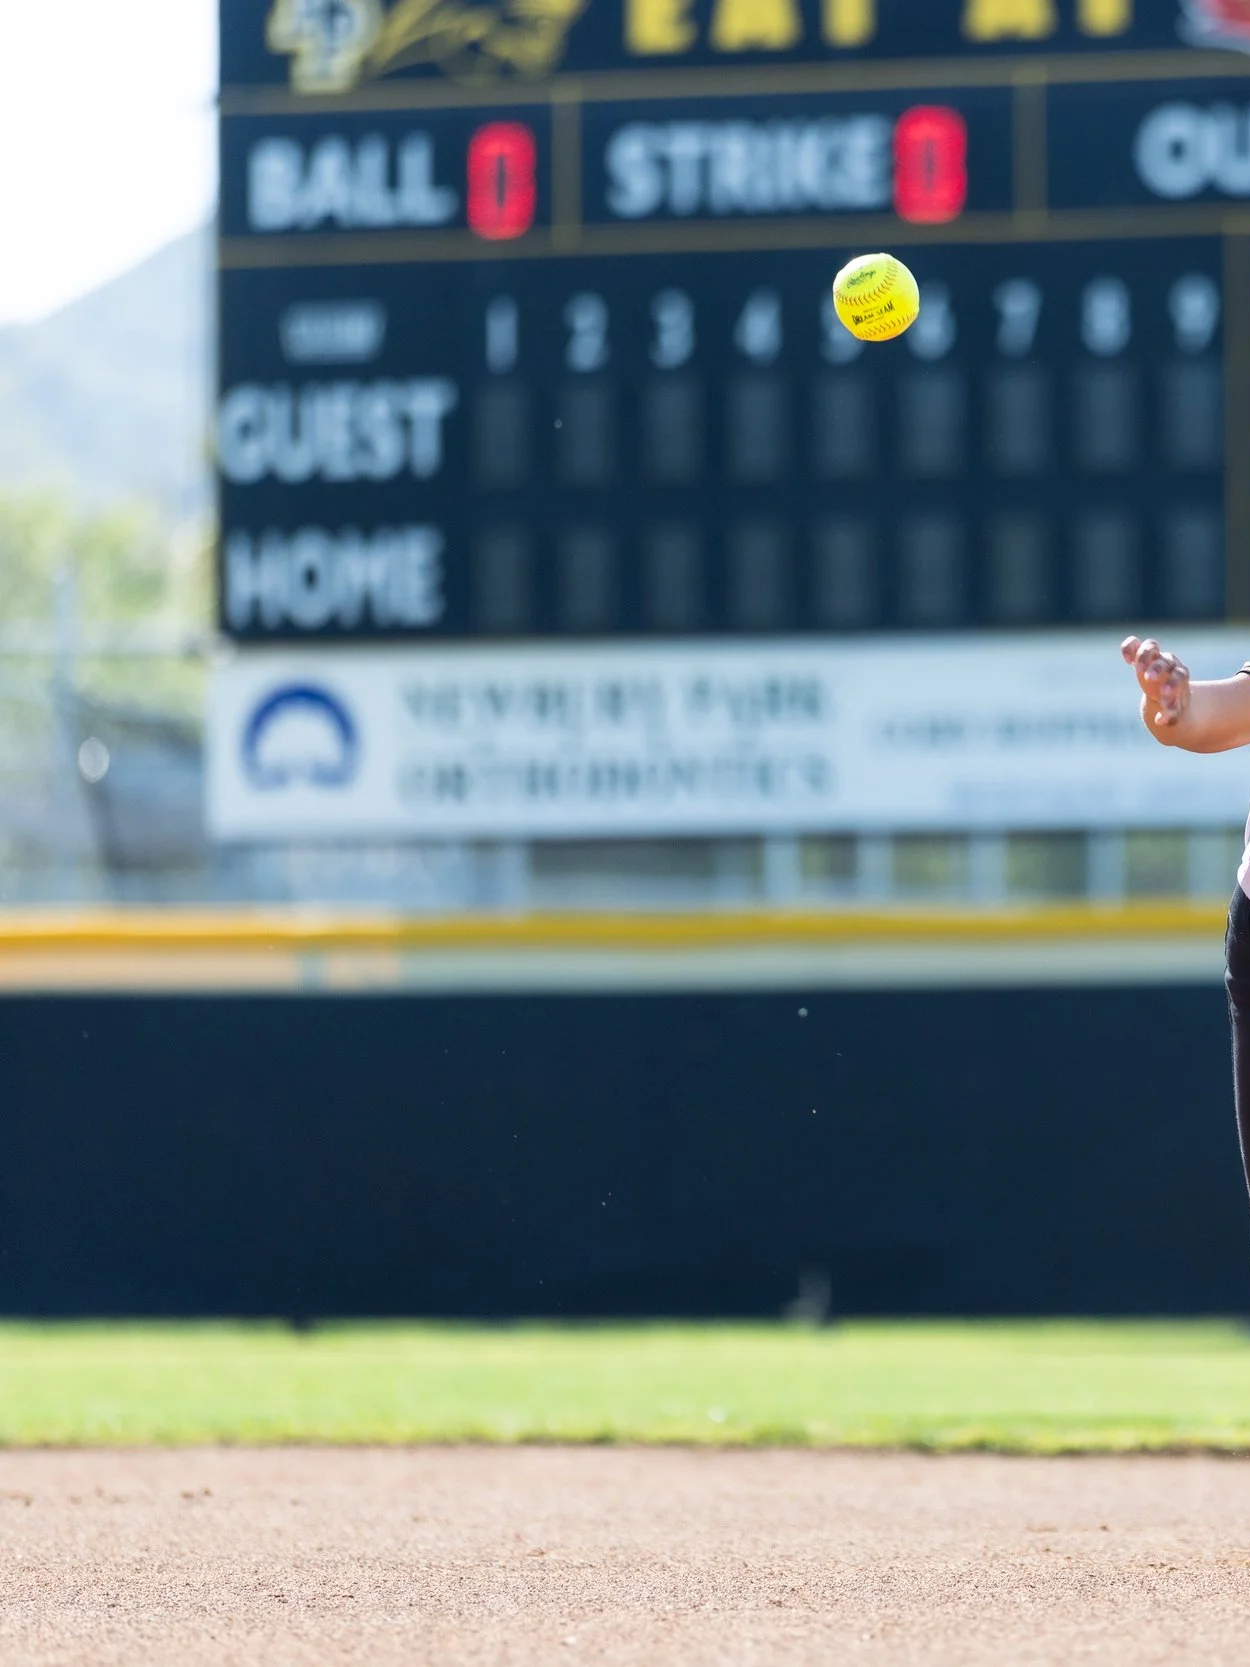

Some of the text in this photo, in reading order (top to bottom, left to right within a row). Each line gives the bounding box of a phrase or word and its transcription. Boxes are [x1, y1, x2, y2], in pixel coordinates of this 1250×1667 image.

[248, 122, 536, 240] BALL 0
[607, 105, 967, 224] STRIKE 0
[486, 297, 519, 373] 1
[566, 291, 608, 373] 2
[652, 288, 695, 369] 3
[736, 288, 782, 365] 4
[994, 277, 1041, 355] 7
[1082, 277, 1130, 355] 8
[1170, 274, 1219, 351] 9
[218, 377, 456, 483] GUEST
[226, 526, 442, 630] HOME
